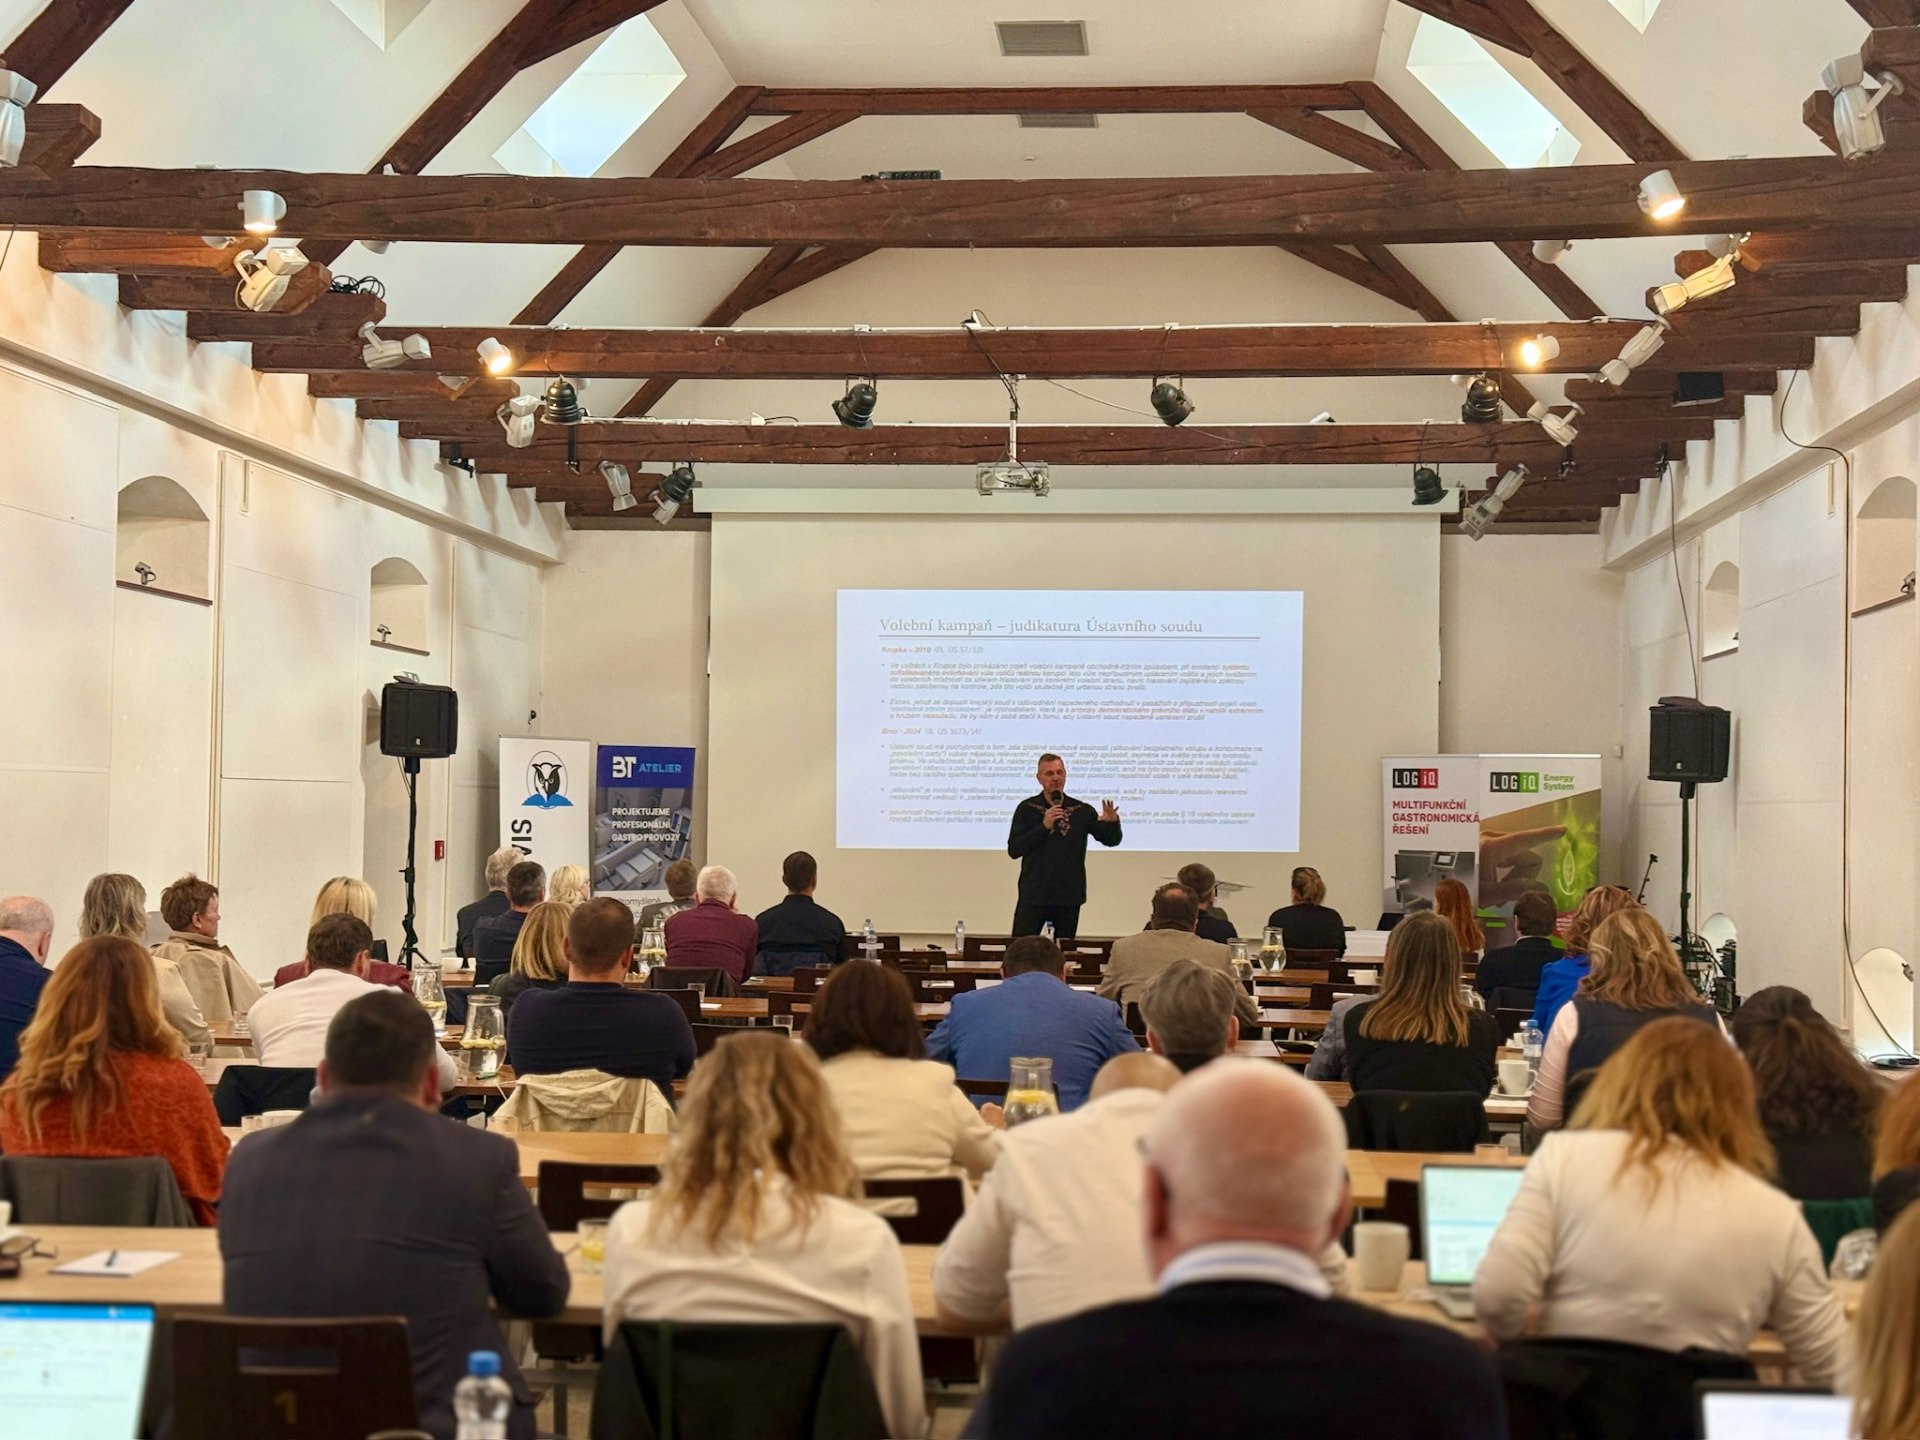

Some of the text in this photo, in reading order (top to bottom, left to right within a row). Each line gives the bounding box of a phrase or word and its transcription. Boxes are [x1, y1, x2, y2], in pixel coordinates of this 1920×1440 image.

[880, 618, 932, 632] Volební
[938, 618, 992, 635] kampaň
[1009, 618, 1080, 634] judikatura
[1087, 616, 1156, 632] Ústavního
[1160, 620, 1202, 632] soudu
[612, 755, 682, 778] BT ATELIER
[1543, 774, 1575, 783] Energy
[1543, 783, 1574, 791] System
[1392, 799, 1467, 810] MULTIFUNKČNÍ
[611, 807, 671, 816] PROJEKTUJEME
[1392, 812, 1480, 823] GASTRONOMICKÁ
[611, 818, 671, 829] PROFESIONÁLNÍ
[1392, 823, 1430, 835] ŘEŠENÍ
